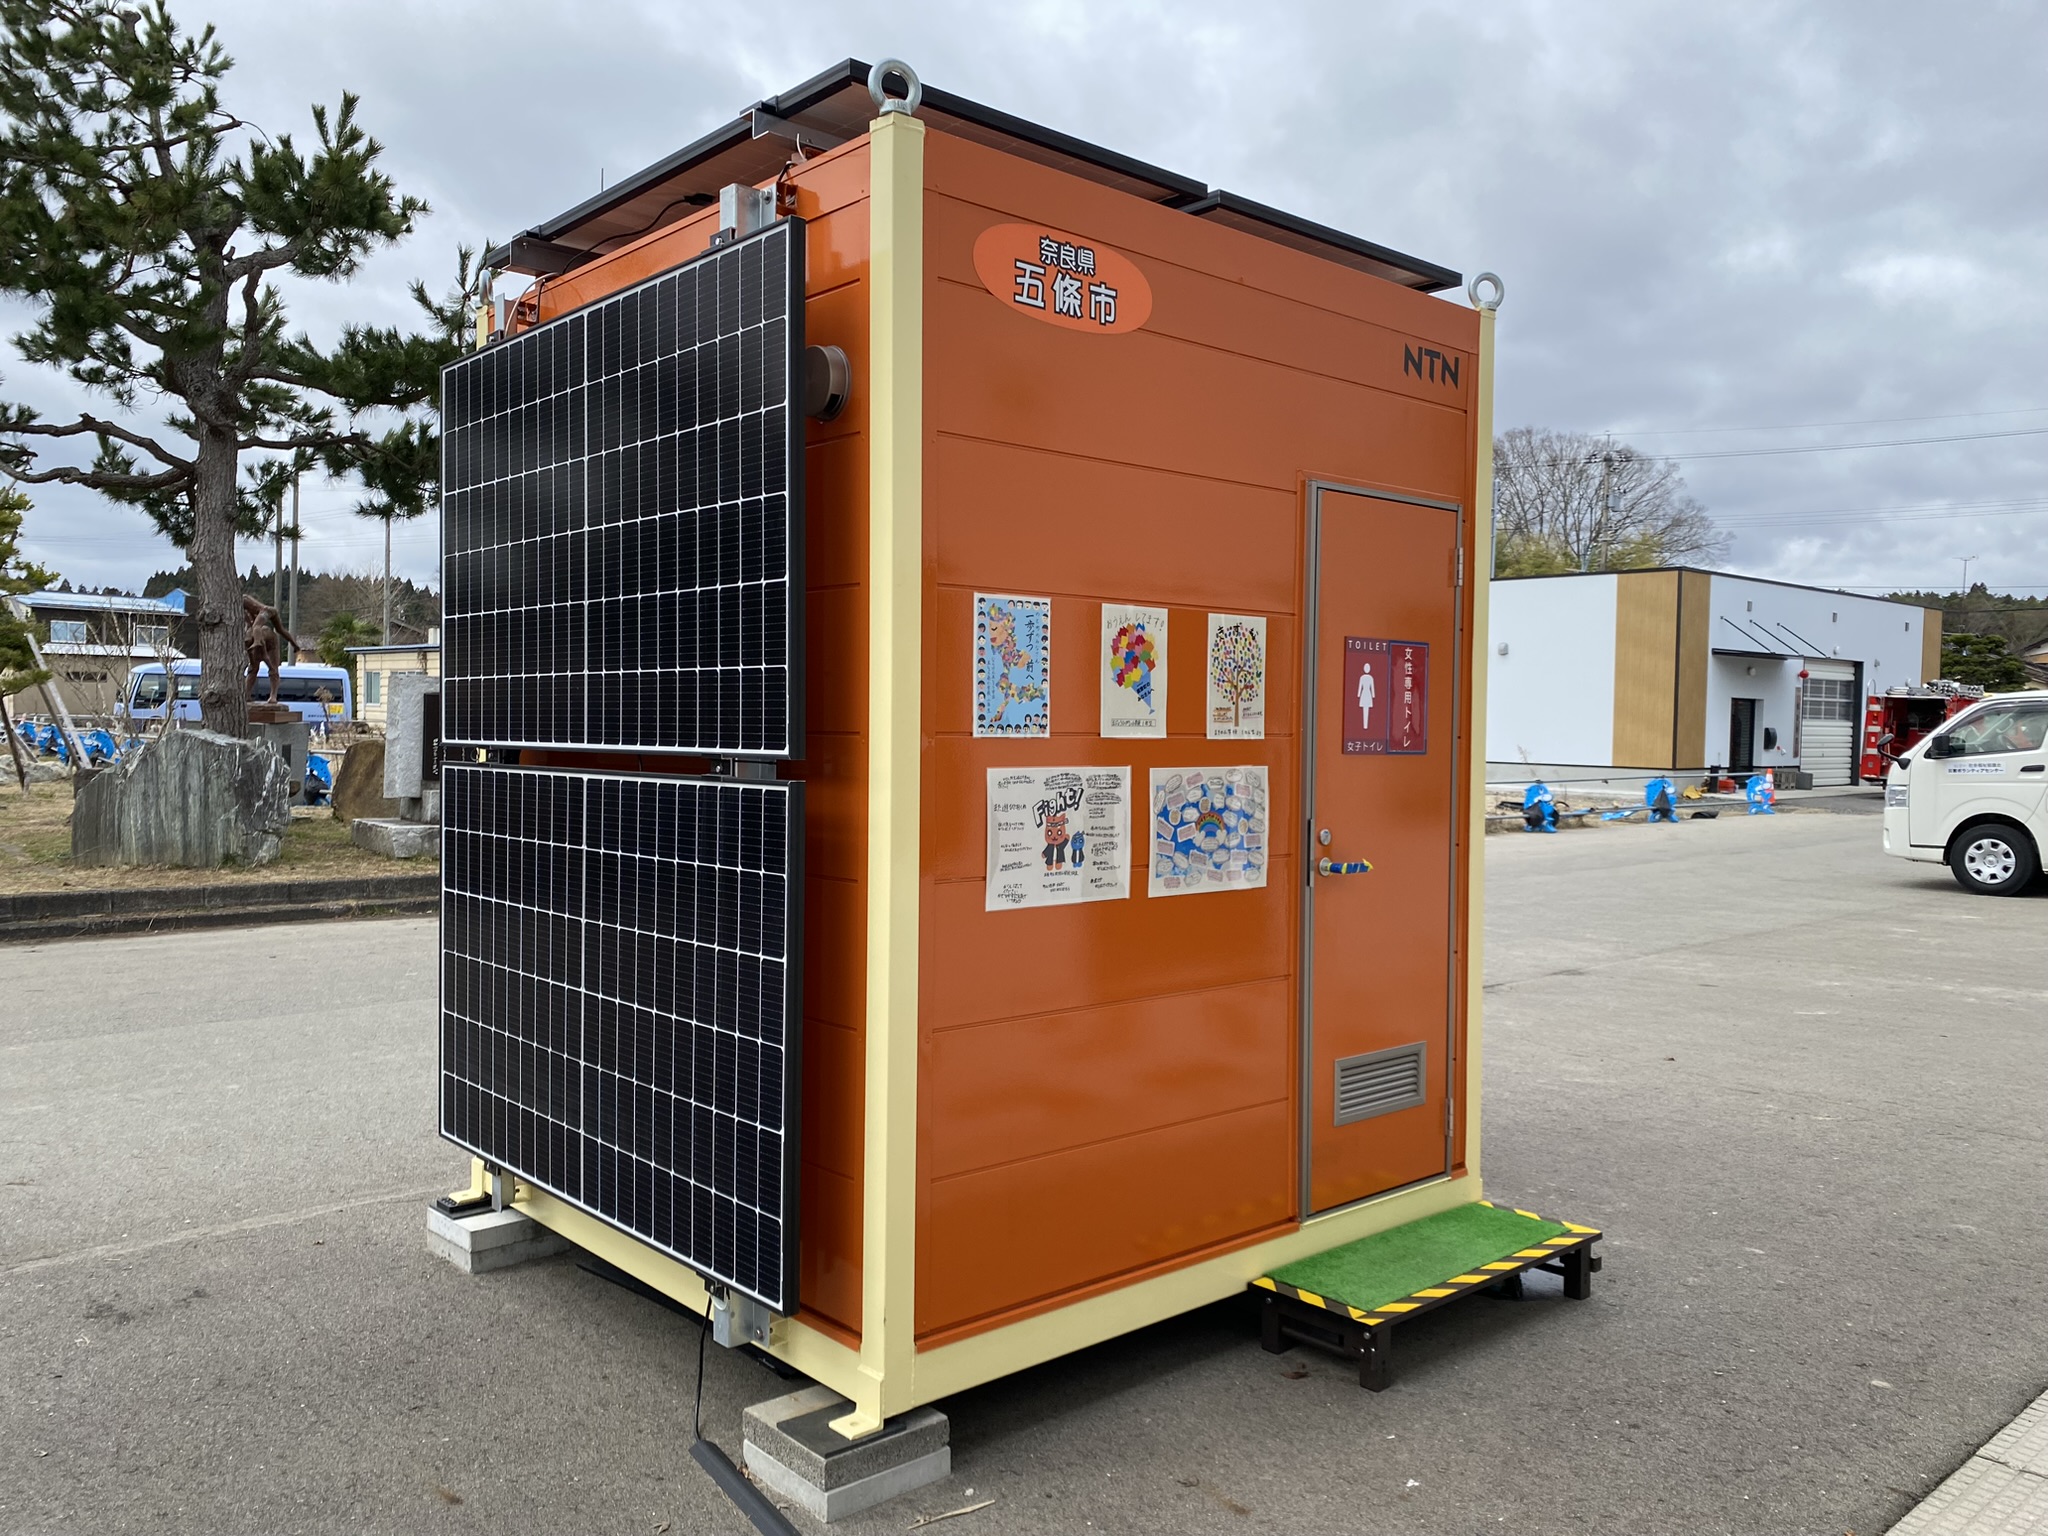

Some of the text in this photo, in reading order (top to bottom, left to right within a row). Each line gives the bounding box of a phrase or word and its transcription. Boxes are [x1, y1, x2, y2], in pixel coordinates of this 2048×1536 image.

[1039, 235, 1096, 276] 奈良県
[1013, 259, 1118, 326] 五條市
[1404, 342, 1460, 389] NTN
[1348, 640, 1387, 651] TOILET
[1403, 647, 1413, 748] 女性専用トイレ
[1347, 741, 1383, 752] 女子トイレ
[1032, 788, 1084, 828] Fight!
